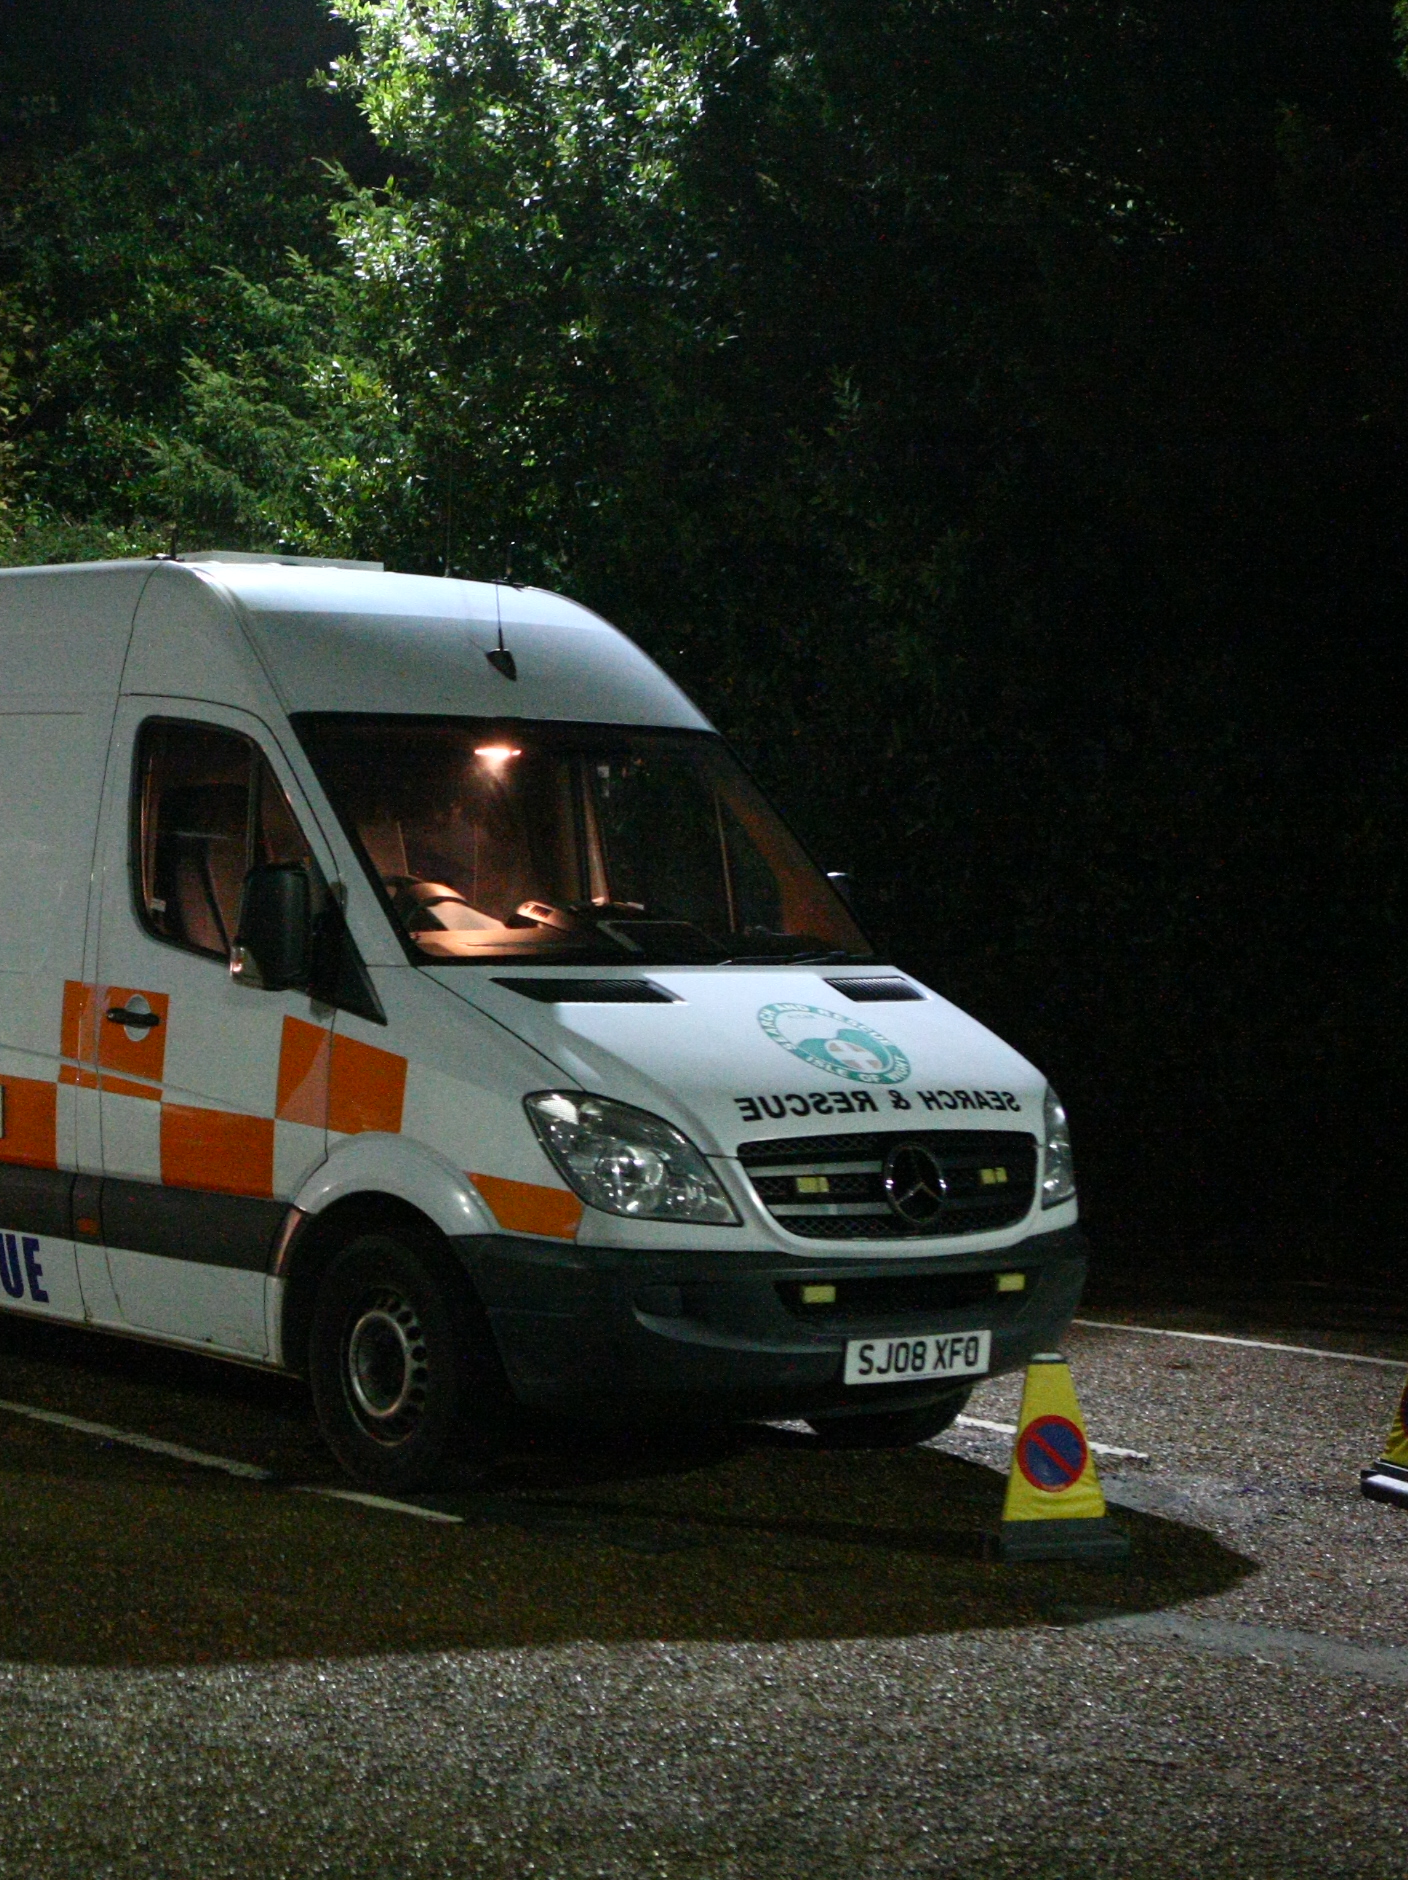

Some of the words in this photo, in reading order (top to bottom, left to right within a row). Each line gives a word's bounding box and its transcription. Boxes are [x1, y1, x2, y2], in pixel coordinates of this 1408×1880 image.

[774, 1003, 810, 1012] AND
[858, 1340, 926, 1376] SJ08
[933, 1336, 980, 1370] XFO
